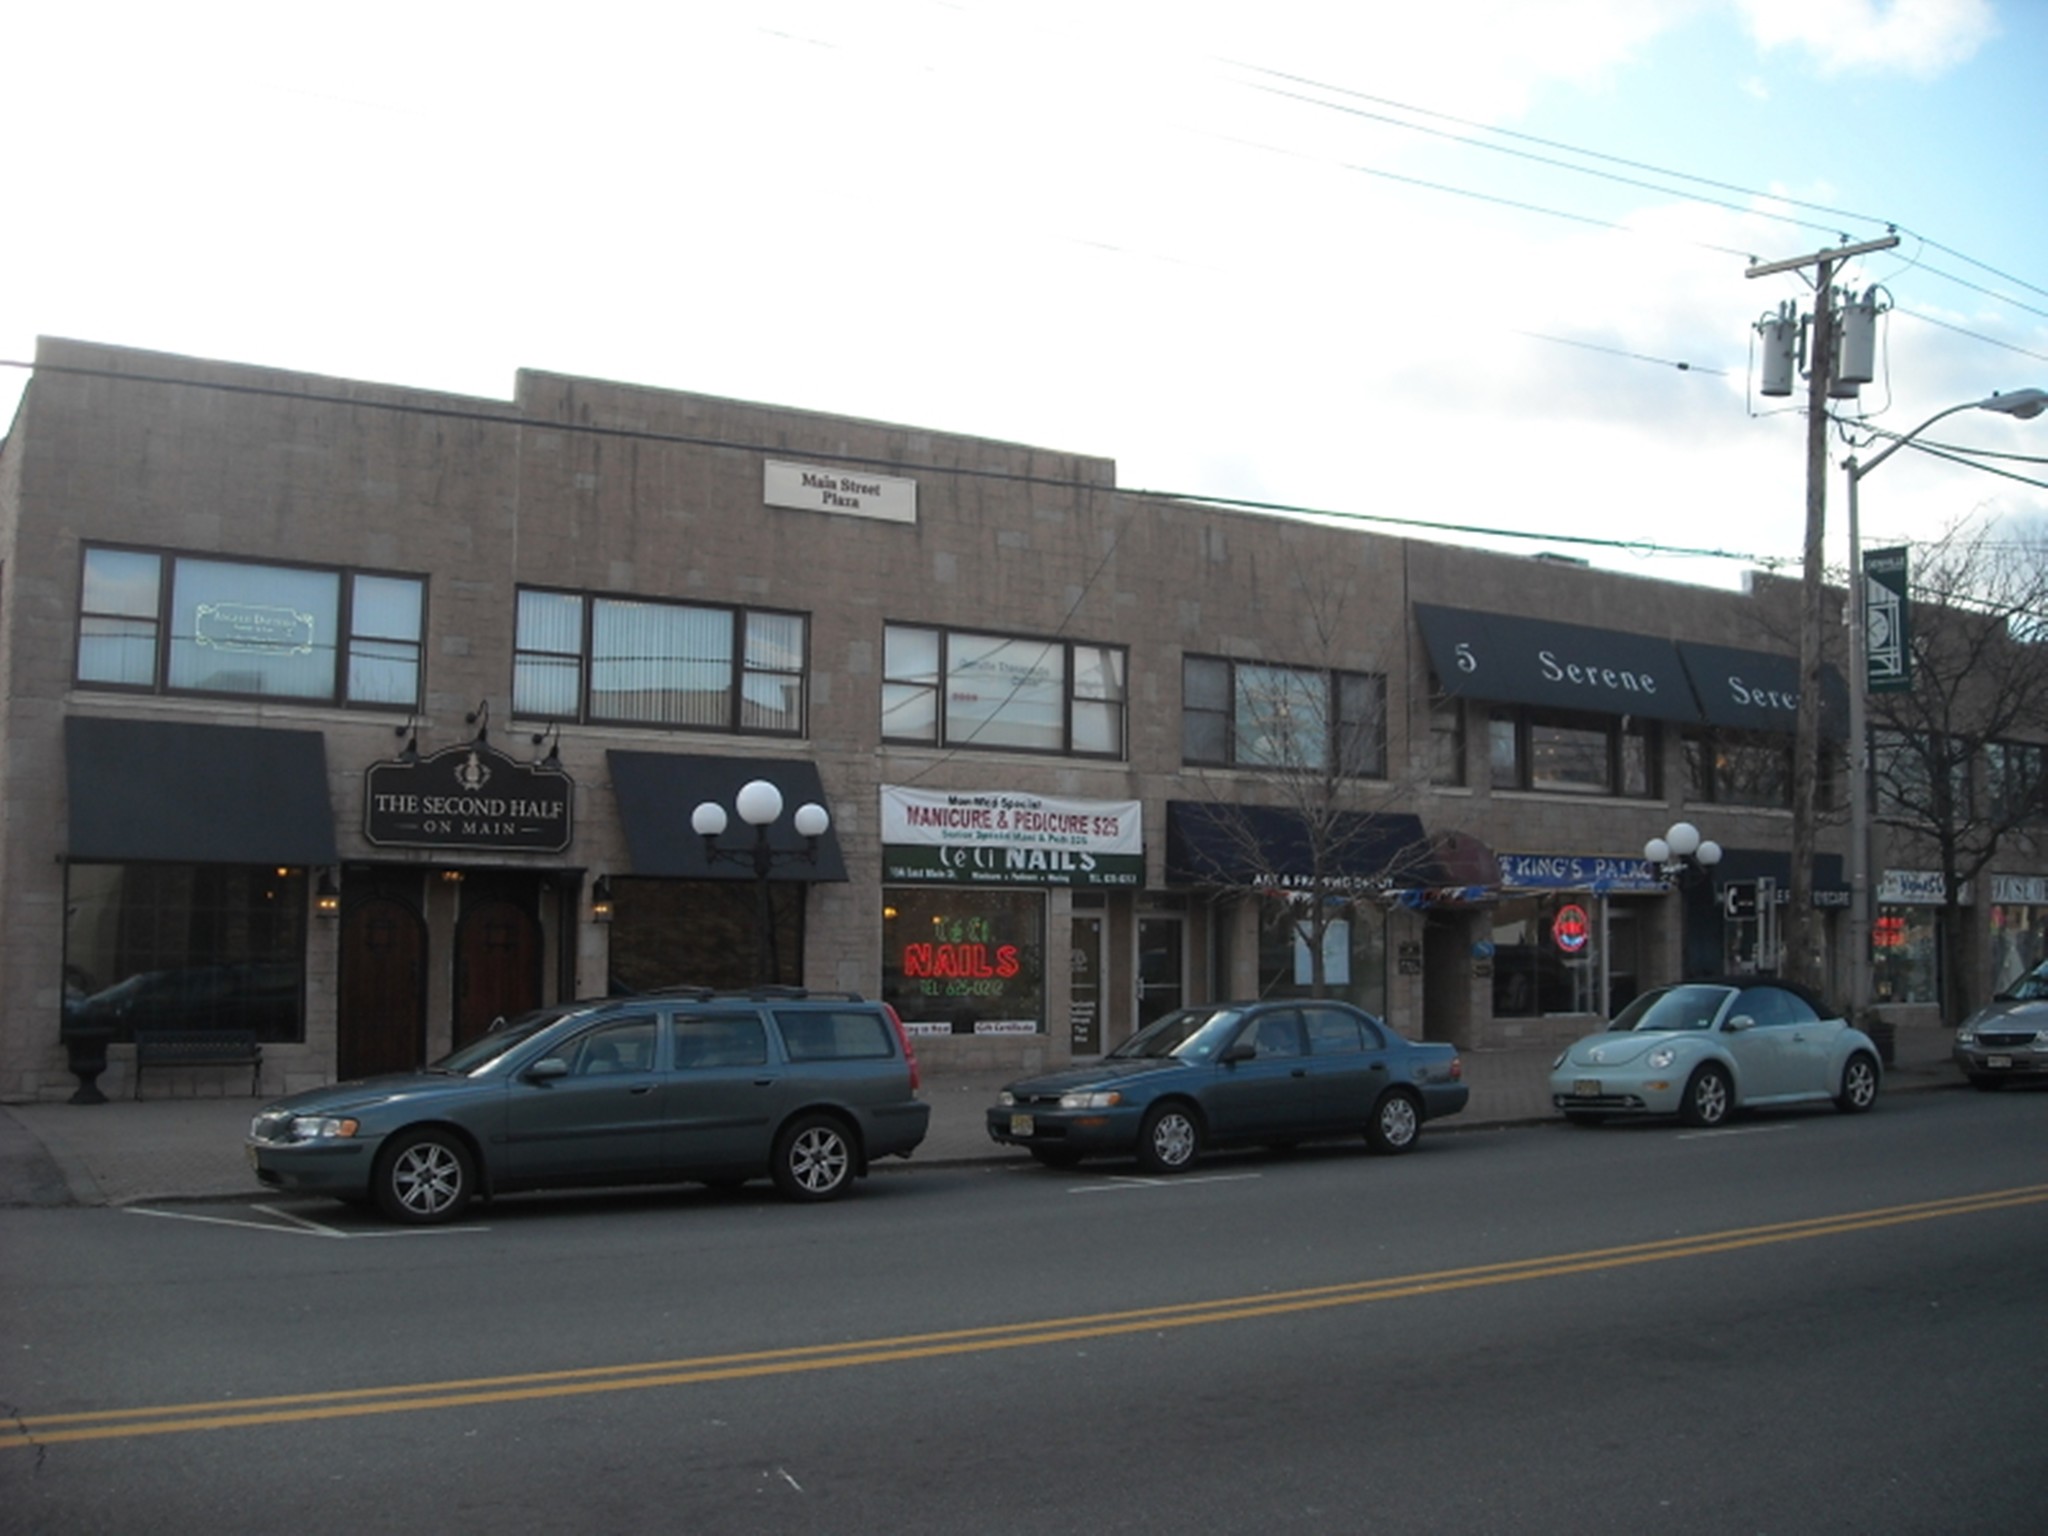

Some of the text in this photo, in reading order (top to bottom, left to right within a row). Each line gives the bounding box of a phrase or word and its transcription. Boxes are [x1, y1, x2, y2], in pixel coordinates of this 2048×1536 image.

[801, 473, 881, 496] Main Street
[822, 491, 860, 508] Plaza
[1456, 643, 1802, 710] 5 Serene Sere
[375, 794, 563, 819] THE SECOND HALF
[423, 820, 515, 835] ON MAIN
[906, 805, 1119, 837] MANICURE & PEDICURE $25
[1006, 848, 1097, 871] NAILS
[1516, 857, 1583, 879] KING'S
[1594, 859, 1653, 881] PALAC
[904, 943, 1019, 977] NAILS
